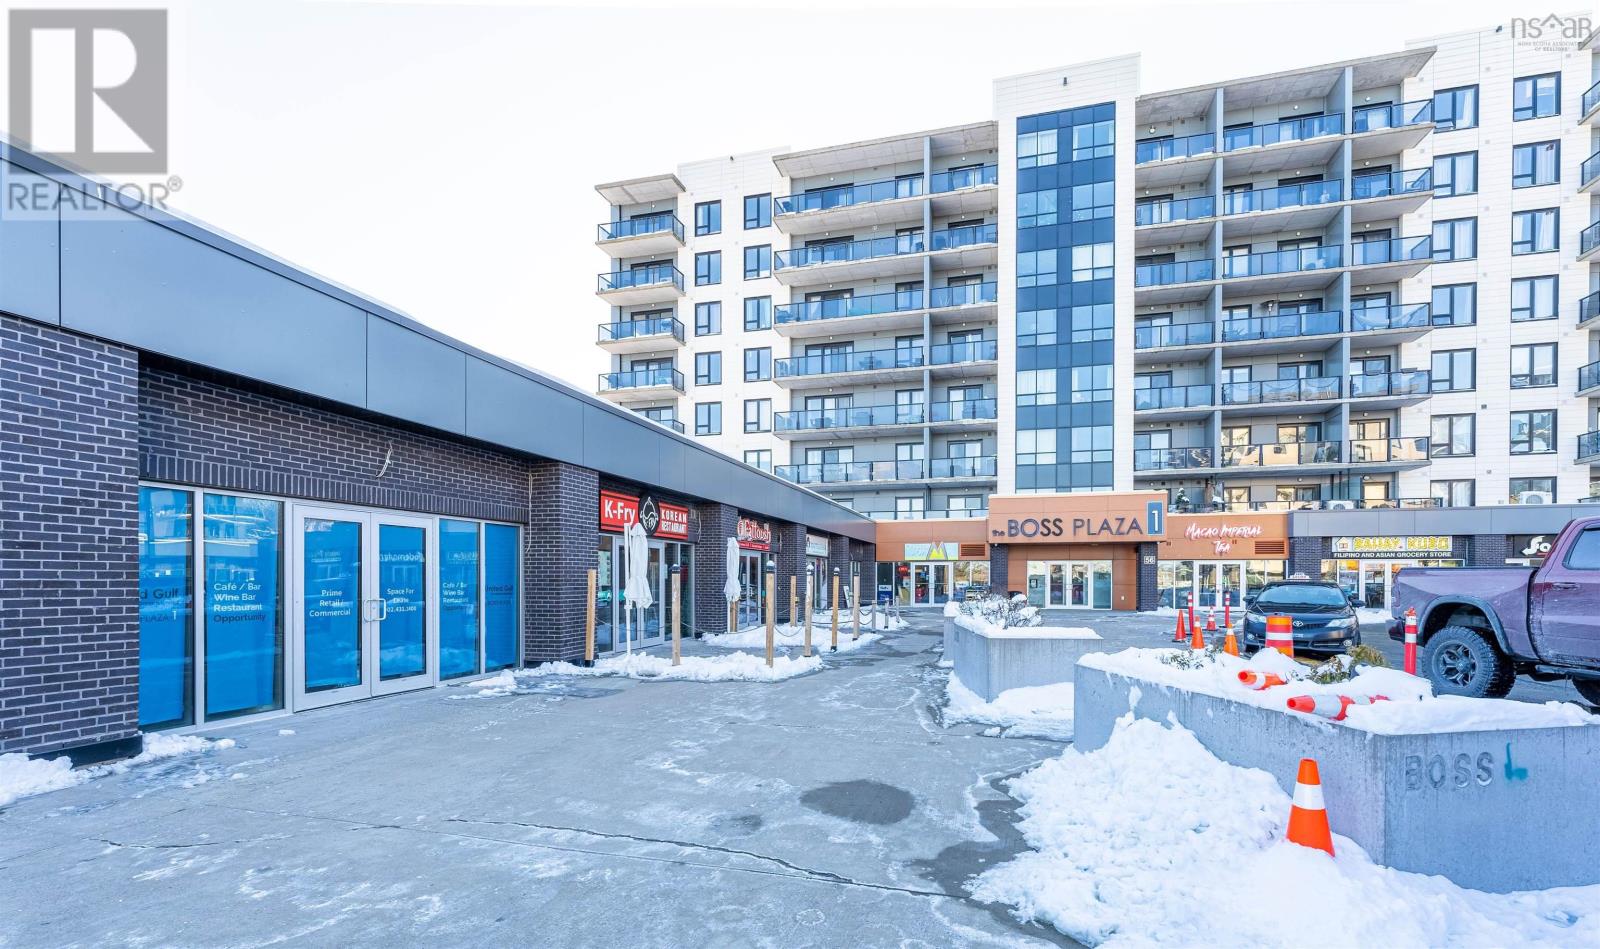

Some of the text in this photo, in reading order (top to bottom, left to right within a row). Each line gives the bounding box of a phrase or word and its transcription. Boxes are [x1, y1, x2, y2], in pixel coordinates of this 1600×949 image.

[604, 499, 636, 525] K-Fry
[661, 509, 687, 523] KOREAN
[661, 521, 687, 534] RESTAURANT
[1007, 518, 1064, 538] BOSS
[1073, 517, 1143, 536] PLAZA
[1145, 556, 1155, 564] 56
[213, 582, 237, 591] Café
[214, 593, 240, 601] Wine
[387, 588, 405, 596] Space
[213, 603, 262, 611] Restaurant
[213, 613, 266, 623] Opportunity
[1405, 751, 1495, 790] BOSS
